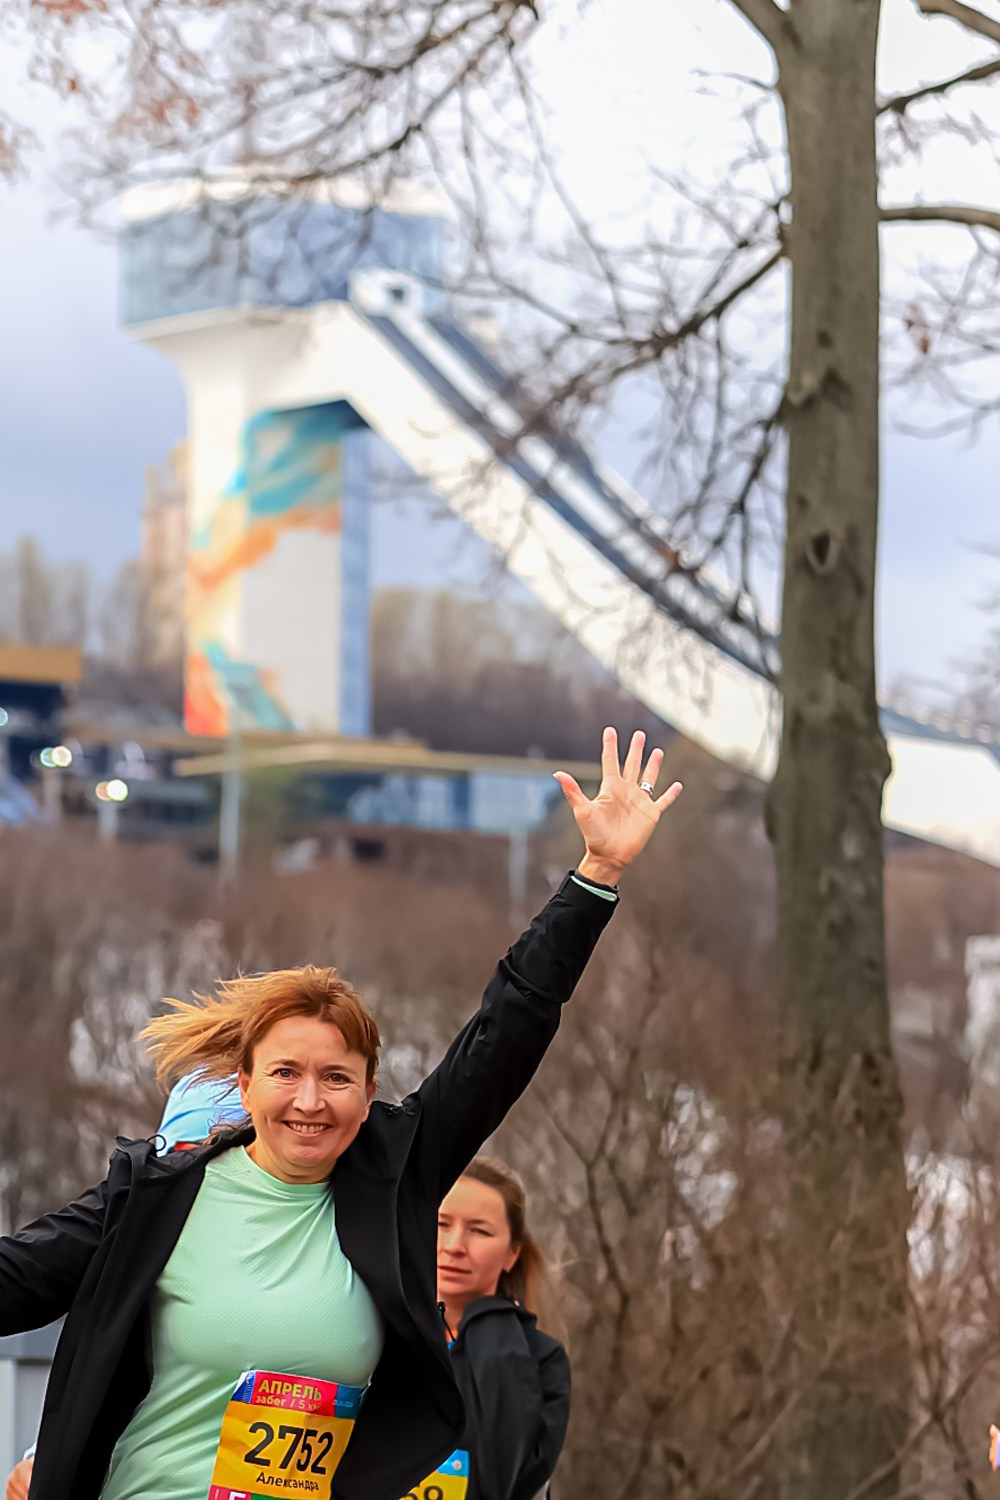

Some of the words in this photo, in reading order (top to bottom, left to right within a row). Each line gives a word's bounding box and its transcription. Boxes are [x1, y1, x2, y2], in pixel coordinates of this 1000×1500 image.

[258, 1379, 322, 1402] АПРЕЛЬ
[255, 1395, 287, 1407] забег
[299, 1399, 306, 1410] 5
[243, 1421, 334, 1475] 2752
[255, 1471, 320, 1492] Александра
